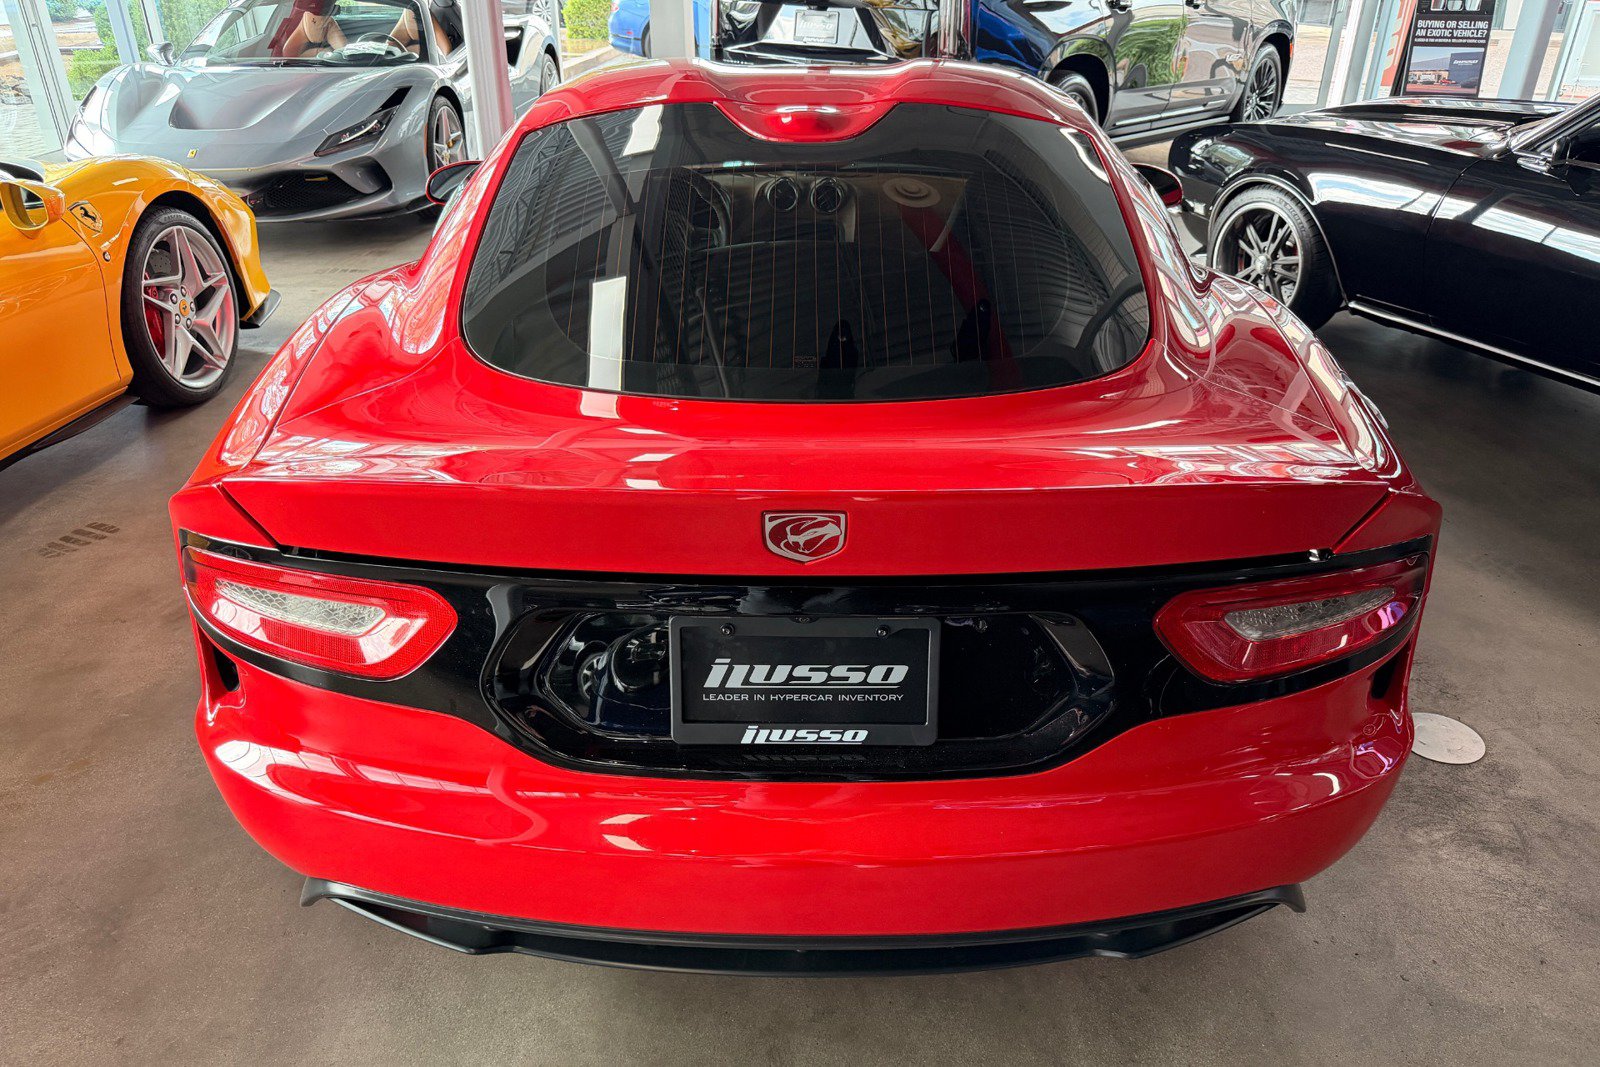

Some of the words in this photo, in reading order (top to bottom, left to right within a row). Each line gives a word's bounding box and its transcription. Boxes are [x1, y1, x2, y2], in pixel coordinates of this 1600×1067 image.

[1417, 20, 1445, 29] BUYING
[1446, 20, 1457, 29] OR
[1457, 21, 1489, 29] SELLING
[1415, 29, 1426, 37] AN
[1427, 29, 1452, 37] EXOTIC
[1453, 29, 1488, 38] VEHICLE?
[702, 693, 749, 701] LEADER
[753, 693, 765, 701] IN
[770, 693, 833, 702] HYPERCAR
[838, 693, 904, 702] INVENTORY
